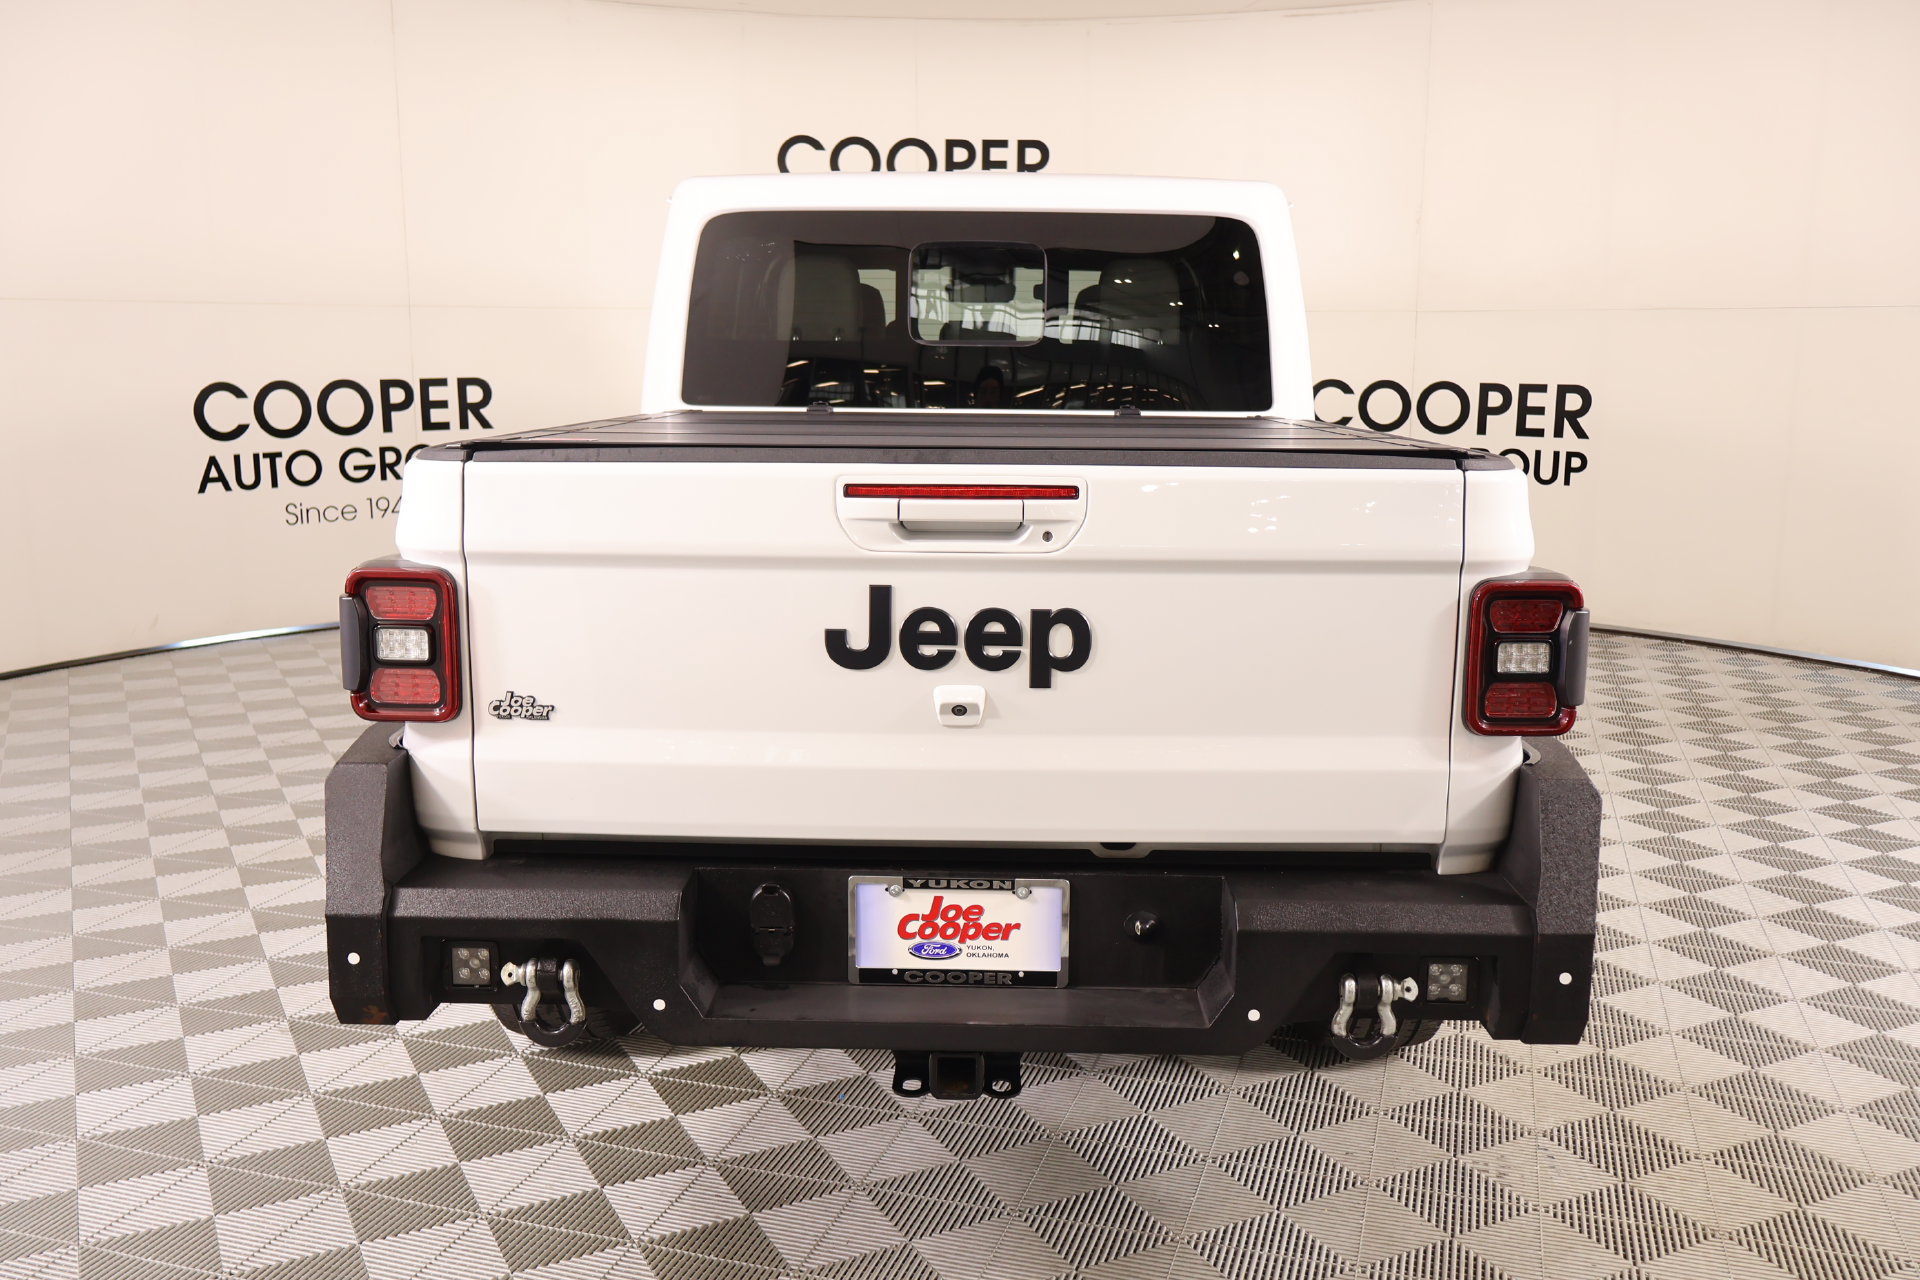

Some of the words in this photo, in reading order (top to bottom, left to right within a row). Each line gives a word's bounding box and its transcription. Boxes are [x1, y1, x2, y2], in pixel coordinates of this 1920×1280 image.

[777, 134, 1050, 173] COOPER
[193, 376, 494, 442] COOPER
[1312, 378, 1593, 440] COOPER
[197, 449, 323, 494] AUTO
[285, 502, 358, 526] Since
[824, 584, 1092, 689] Jeep
[488, 699, 554, 719] Cooper
[500, 690, 536, 707] Joe
[907, 879, 1013, 891] YUKON
[921, 895, 985, 922] Joe
[897, 913, 1022, 944] Cooper
[921, 943, 948, 955] Ford
[966, 951, 1010, 959] OKLAHOMA
[903, 970, 1013, 985] COOPER
